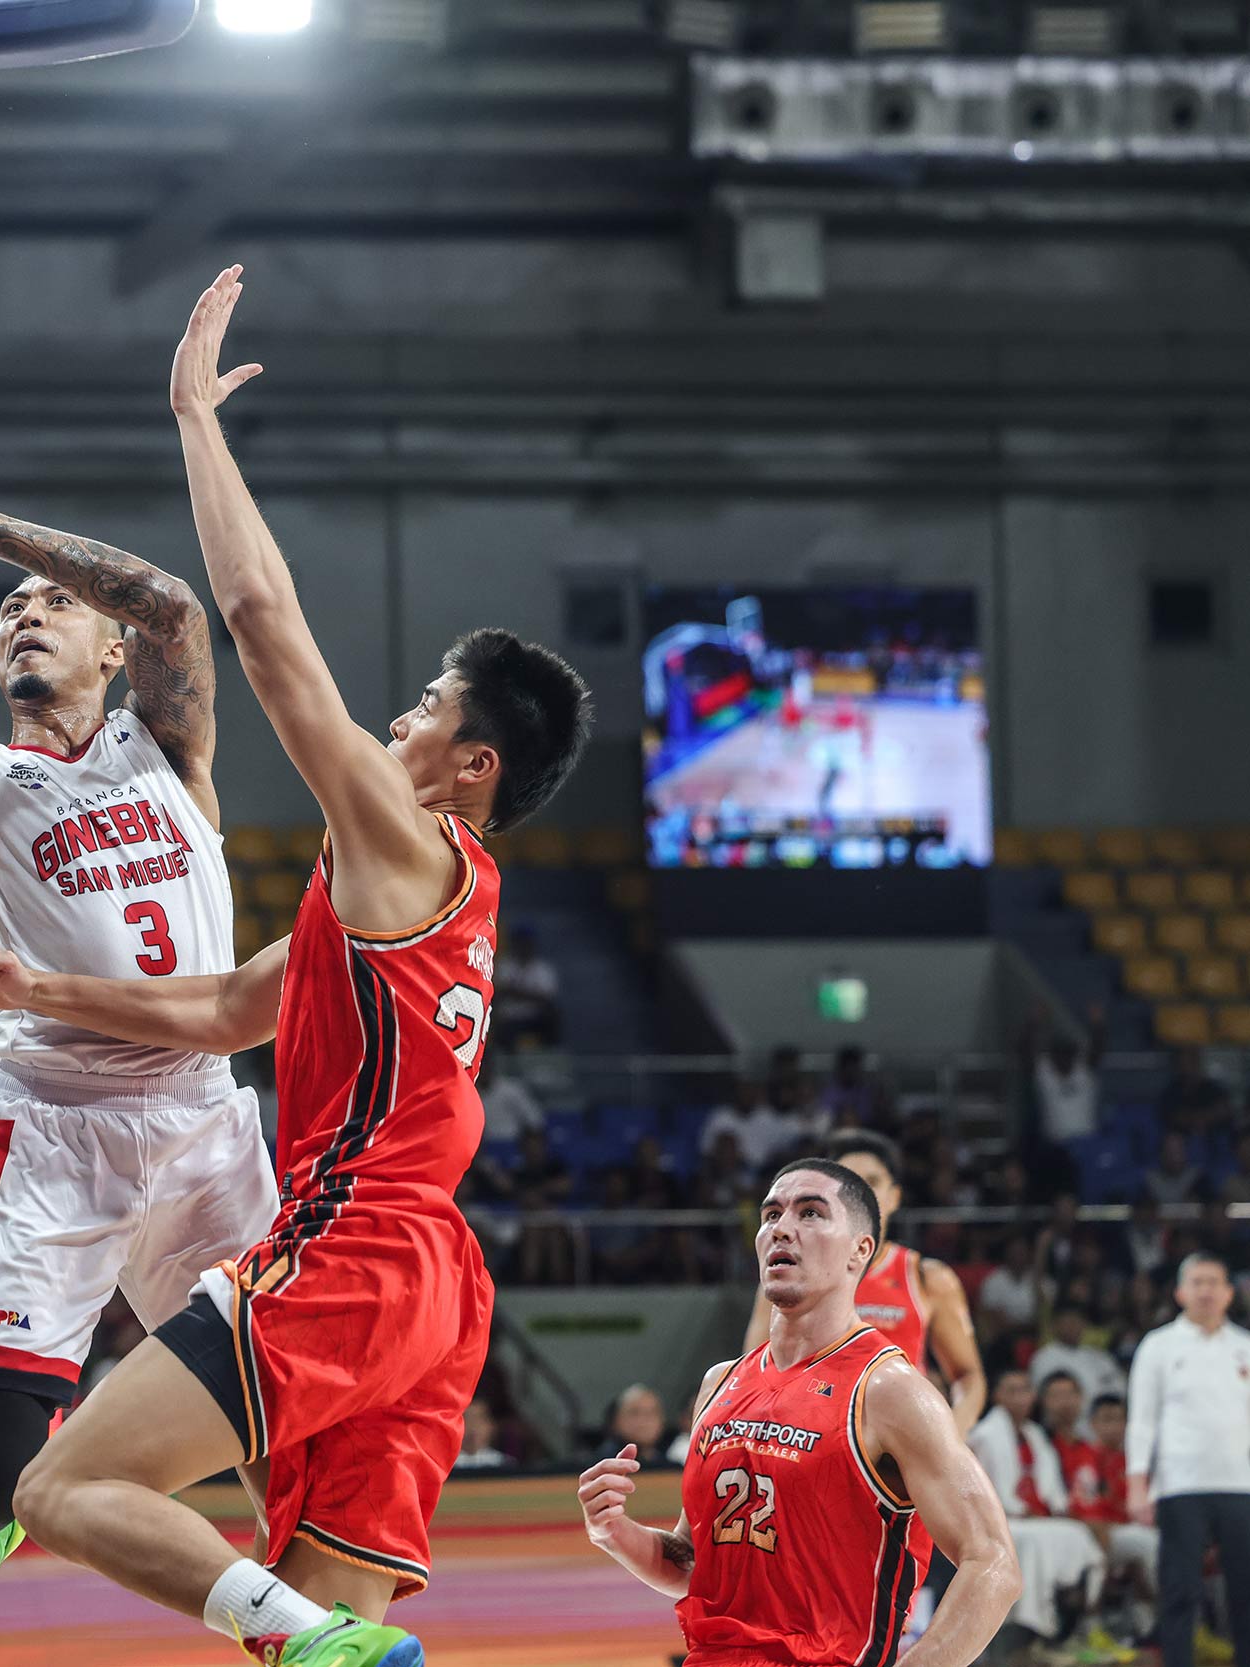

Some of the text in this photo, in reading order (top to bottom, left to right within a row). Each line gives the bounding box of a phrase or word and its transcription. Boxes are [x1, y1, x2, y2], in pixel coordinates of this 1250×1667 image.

[56, 785, 139, 815] BARANGA
[56, 847, 189, 897] SAN MIGUE
[124, 900, 177, 976] 3
[713, 1466, 778, 1555] 22
